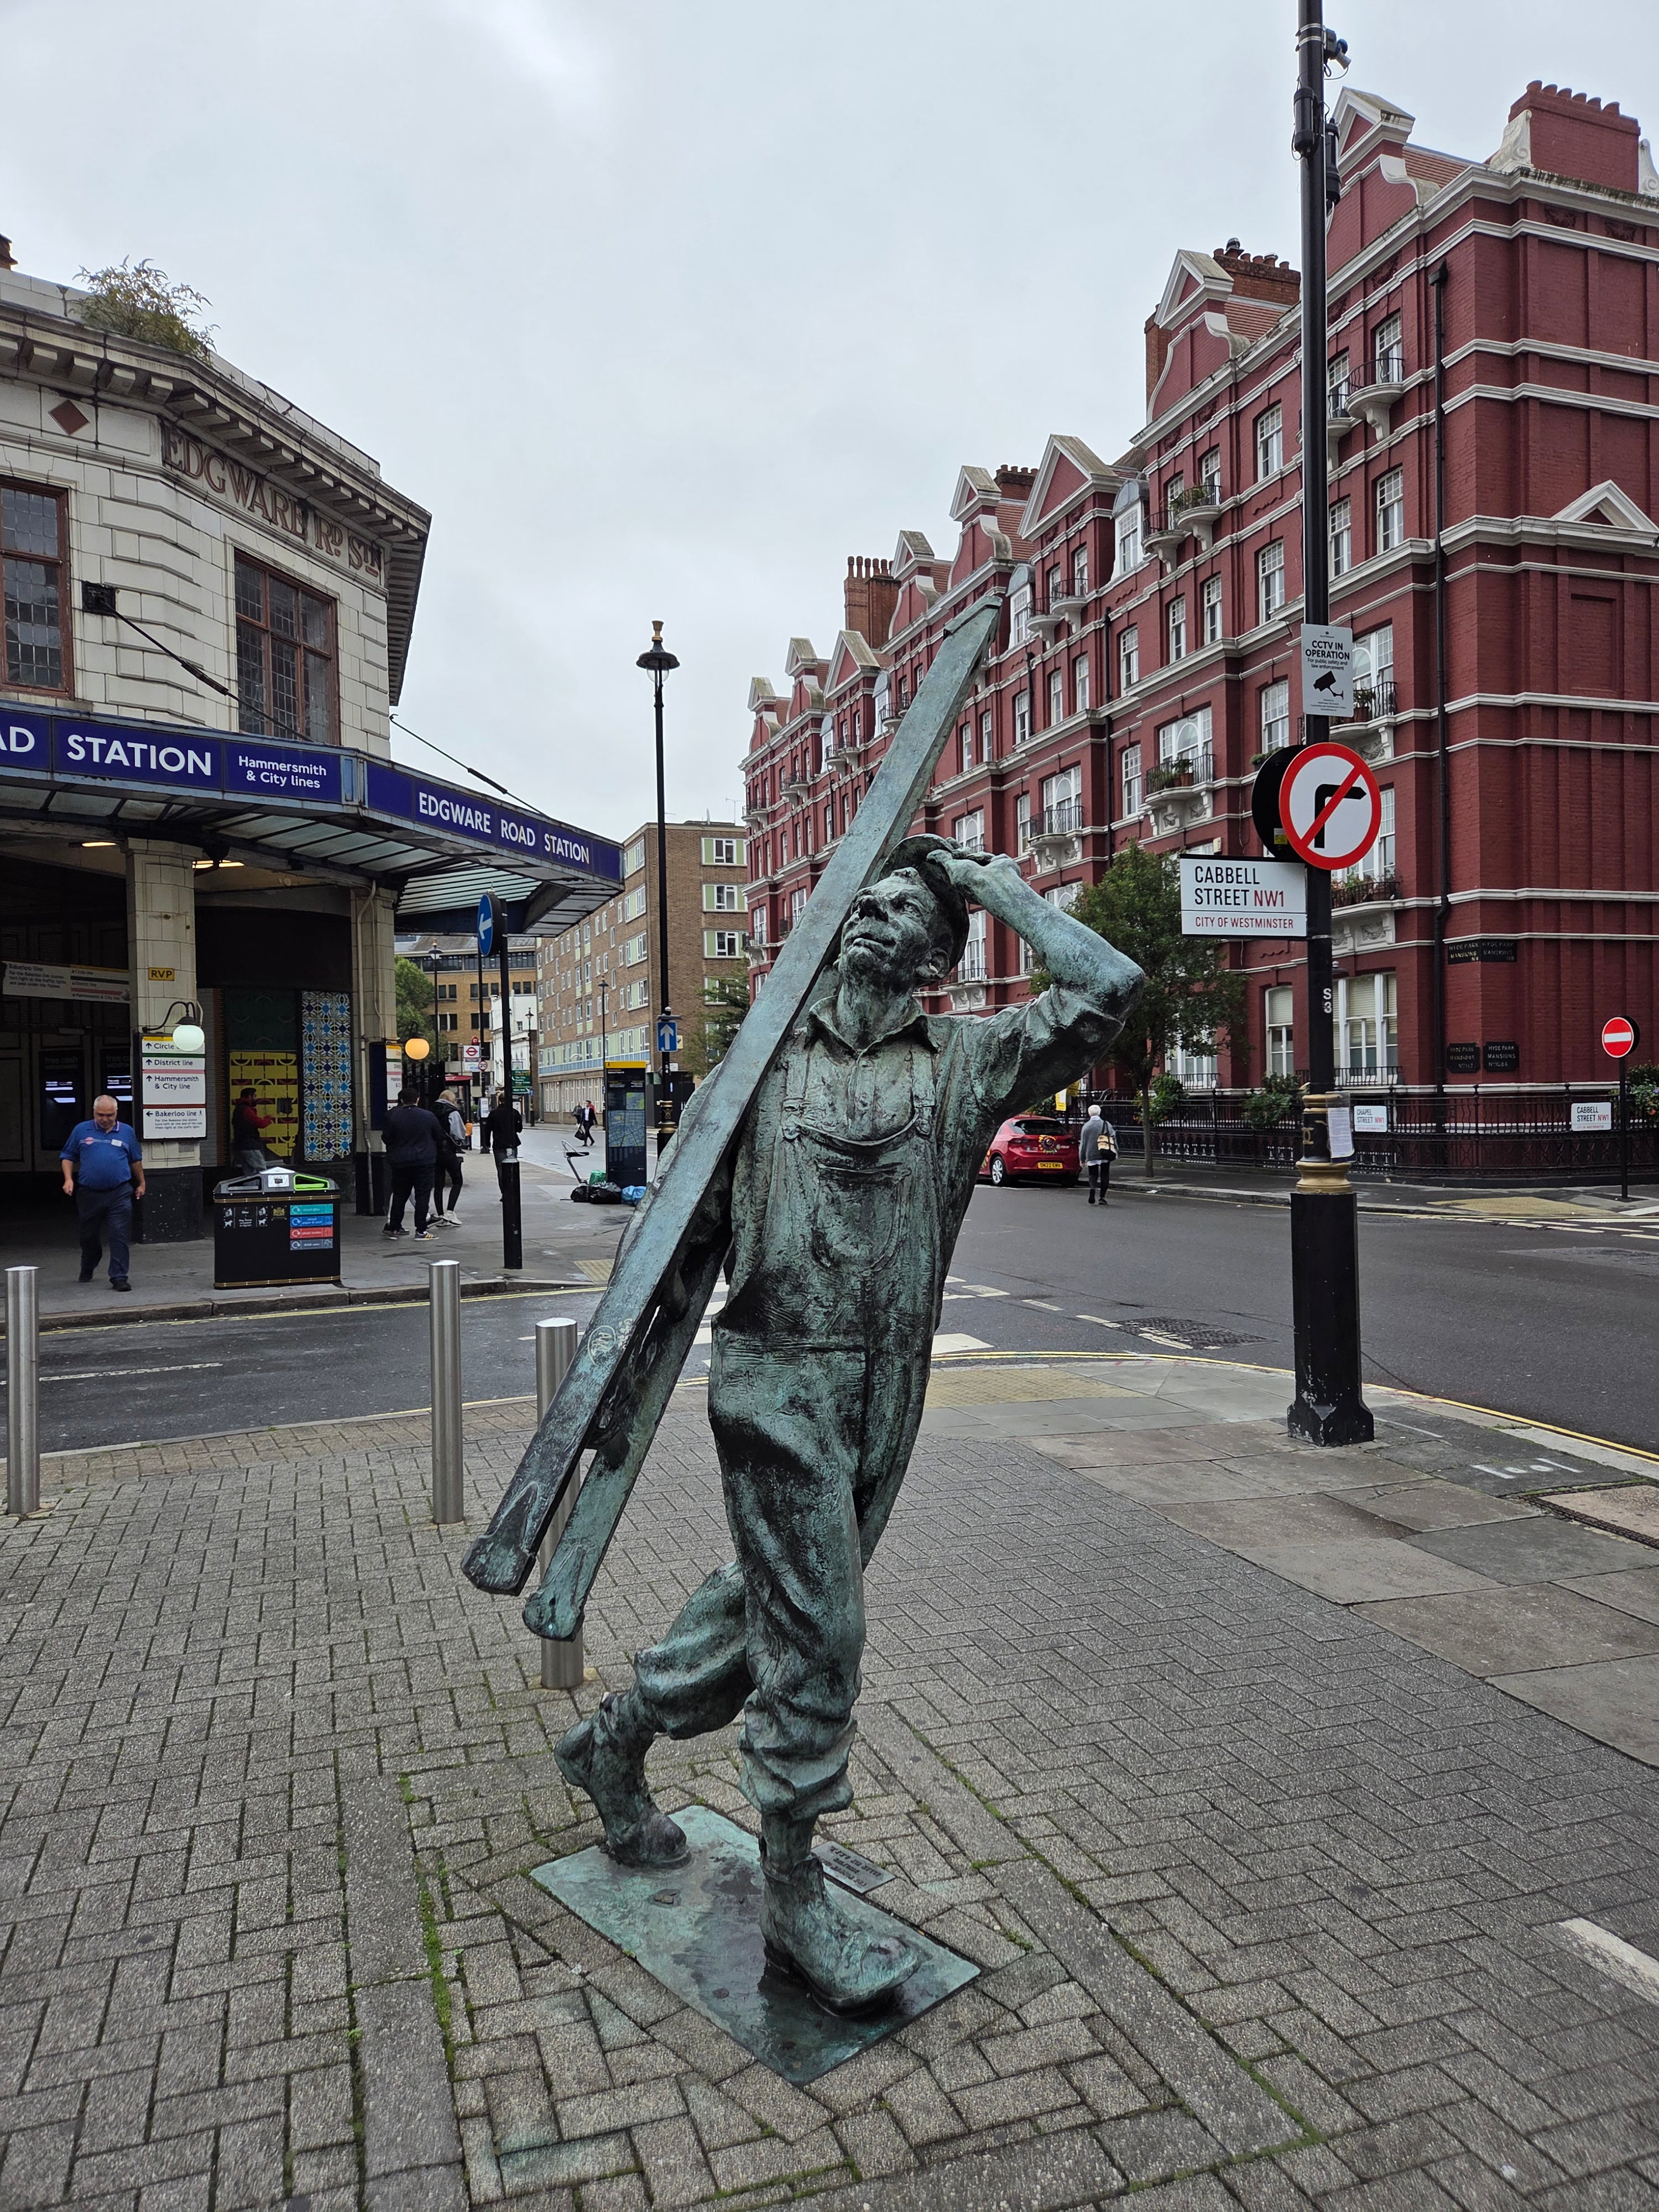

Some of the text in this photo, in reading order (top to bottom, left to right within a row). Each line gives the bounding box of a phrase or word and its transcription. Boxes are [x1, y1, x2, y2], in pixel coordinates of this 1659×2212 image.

[165, 430, 306, 539] EDGWARE
[349, 533, 382, 577] STN
[1305, 649, 1350, 660] OPERATION
[1312, 640, 1333, 650] CCTV
[0, 726, 211, 776] D STATION
[238, 755, 327, 776] Hammersmith
[246, 770, 321, 789] & City lines
[419, 791, 589, 864] EDGWARE ROAD STATION
[1194, 865, 1260, 885] CABBELL
[1194, 888, 1284, 907] STREET NW1
[1195, 916, 1293, 929] CITY OF WESTMINSTER
[151, 969, 173, 978] RVP
[1323, 988, 1332, 1000] S
